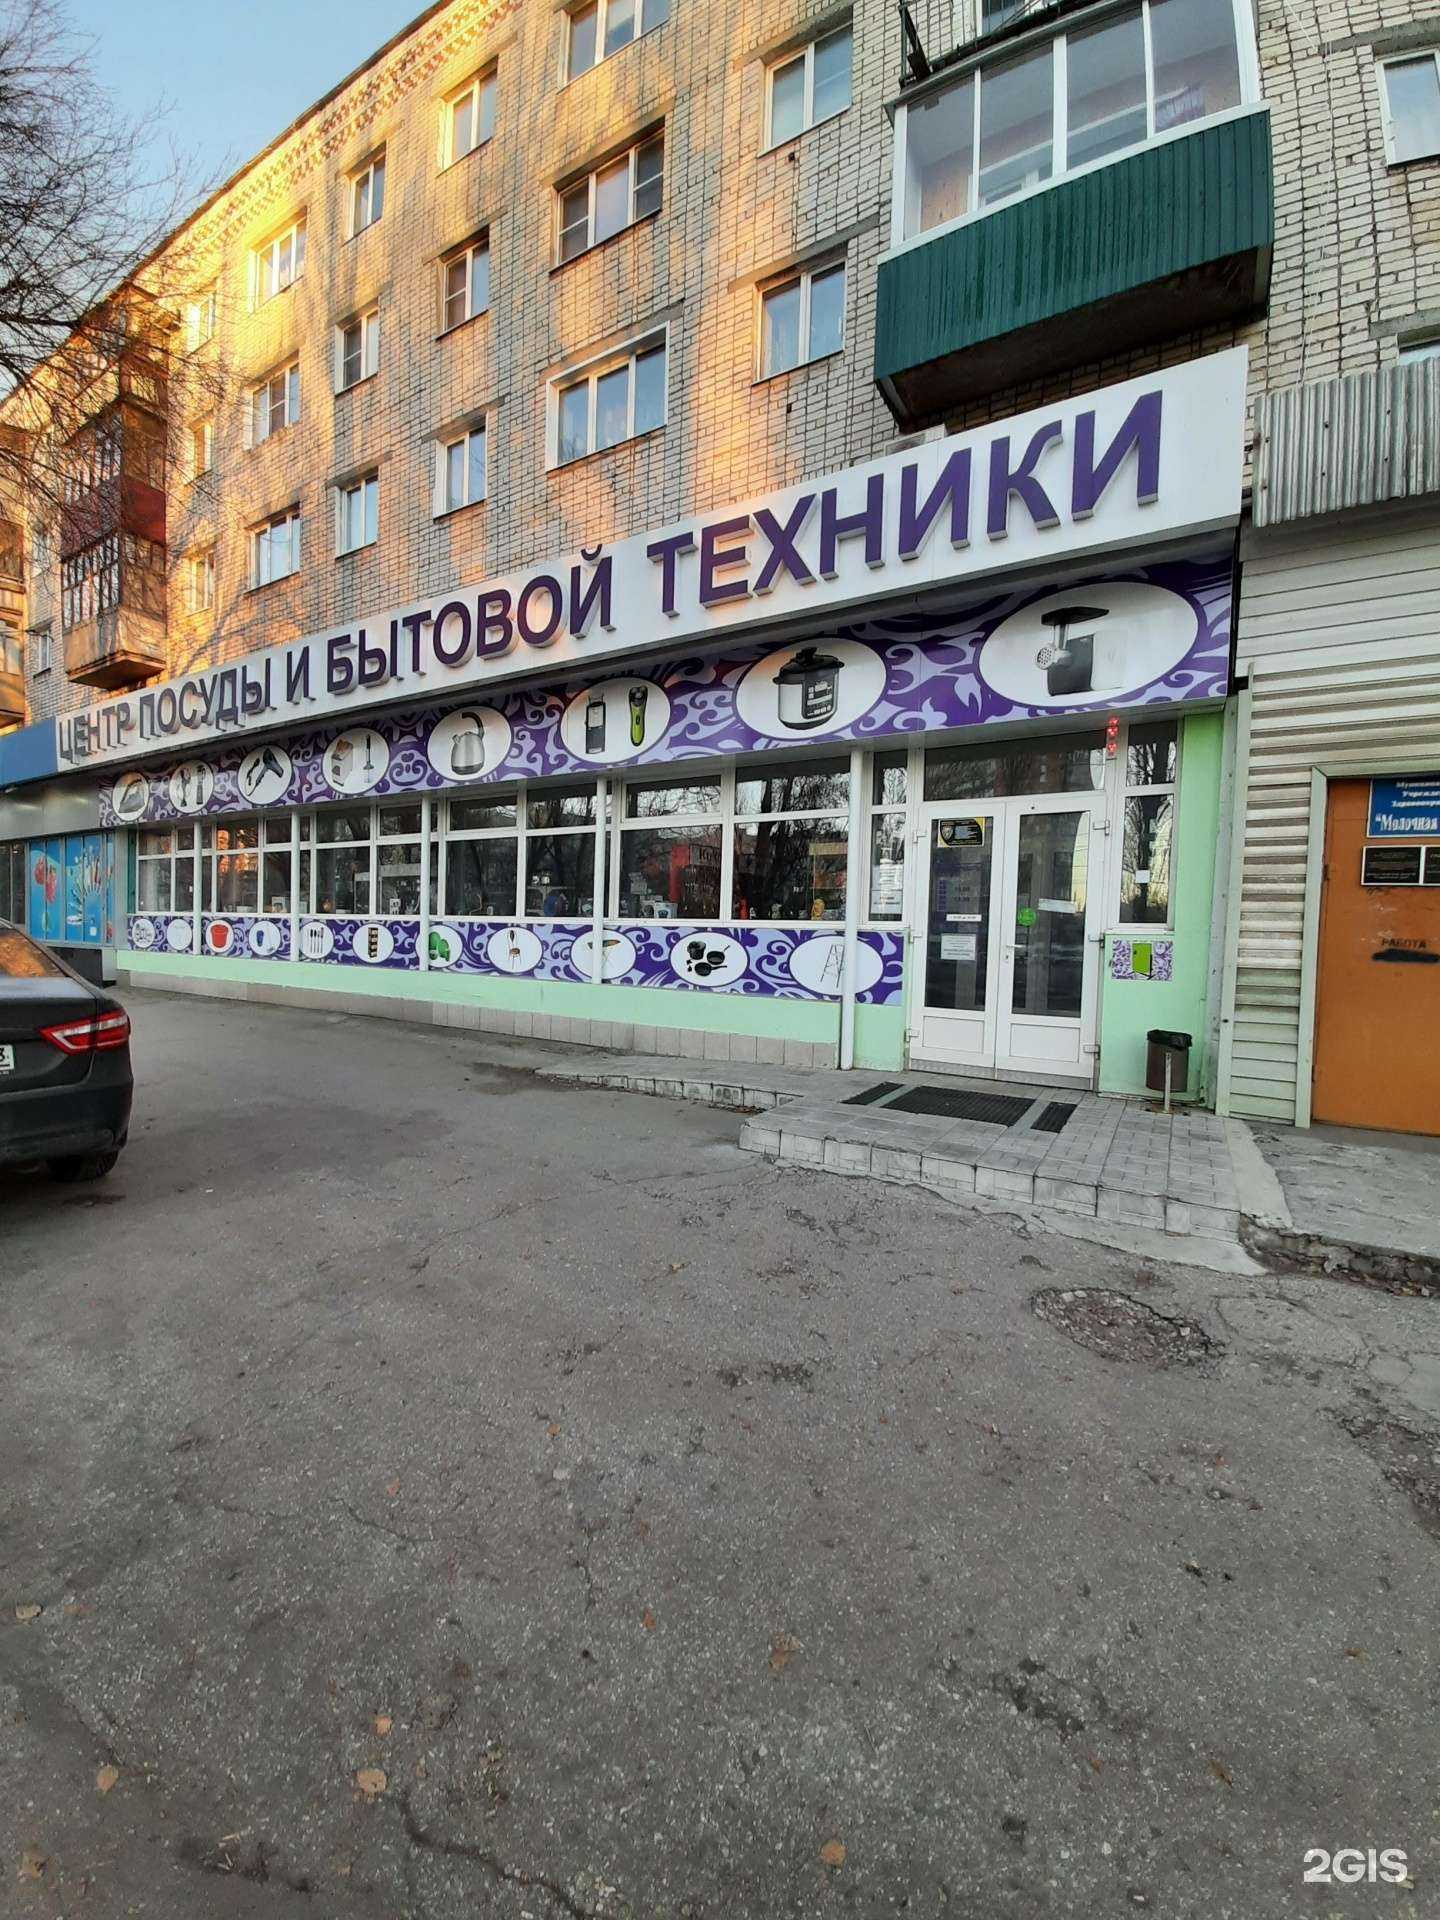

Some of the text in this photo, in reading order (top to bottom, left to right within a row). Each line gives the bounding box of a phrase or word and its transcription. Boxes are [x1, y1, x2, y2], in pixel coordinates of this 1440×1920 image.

[59, 390, 1163, 764] ЦЕНТР ПОСУДЫ И БЫТОВОЙ ТЕХНИКИ
